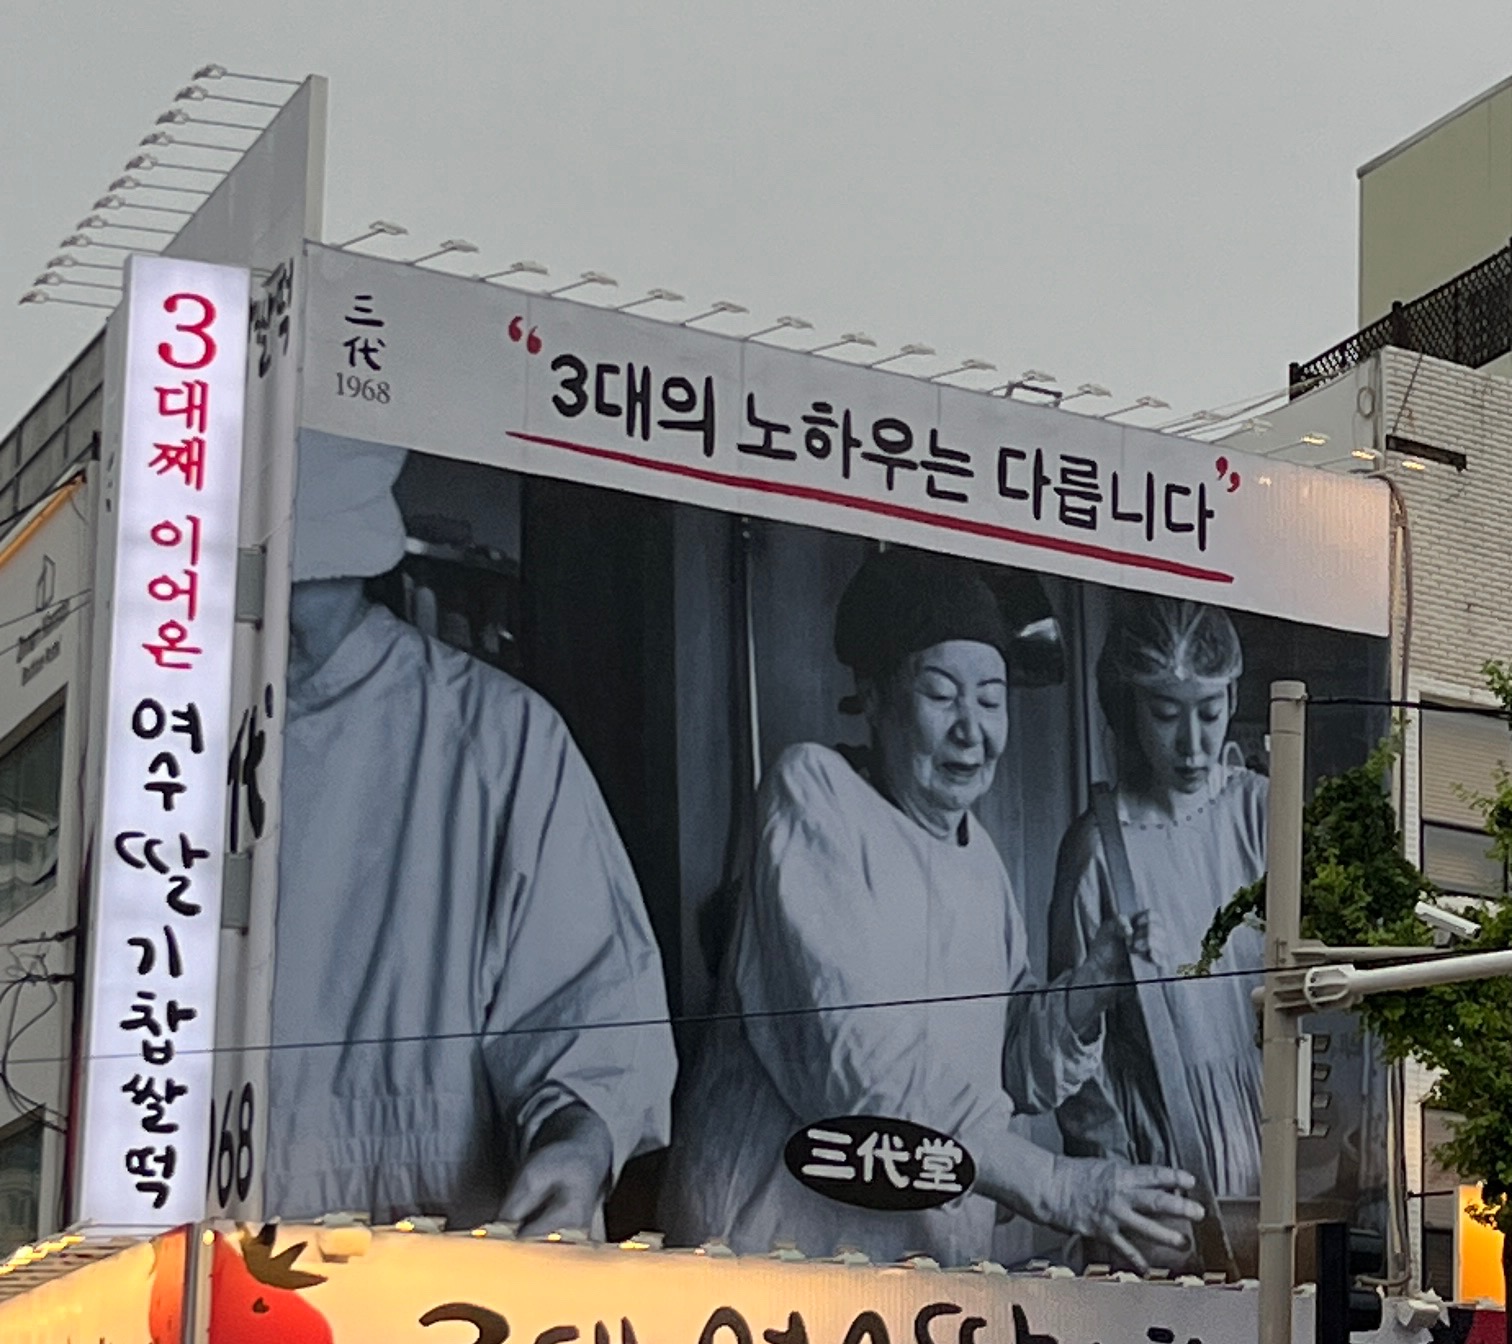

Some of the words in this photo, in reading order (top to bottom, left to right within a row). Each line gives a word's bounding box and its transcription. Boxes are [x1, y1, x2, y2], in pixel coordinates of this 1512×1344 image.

[334, 372, 392, 406] 1968
[737, 390, 974, 504] 노하우는
[801, 1127, 963, 1193] 三代堂
